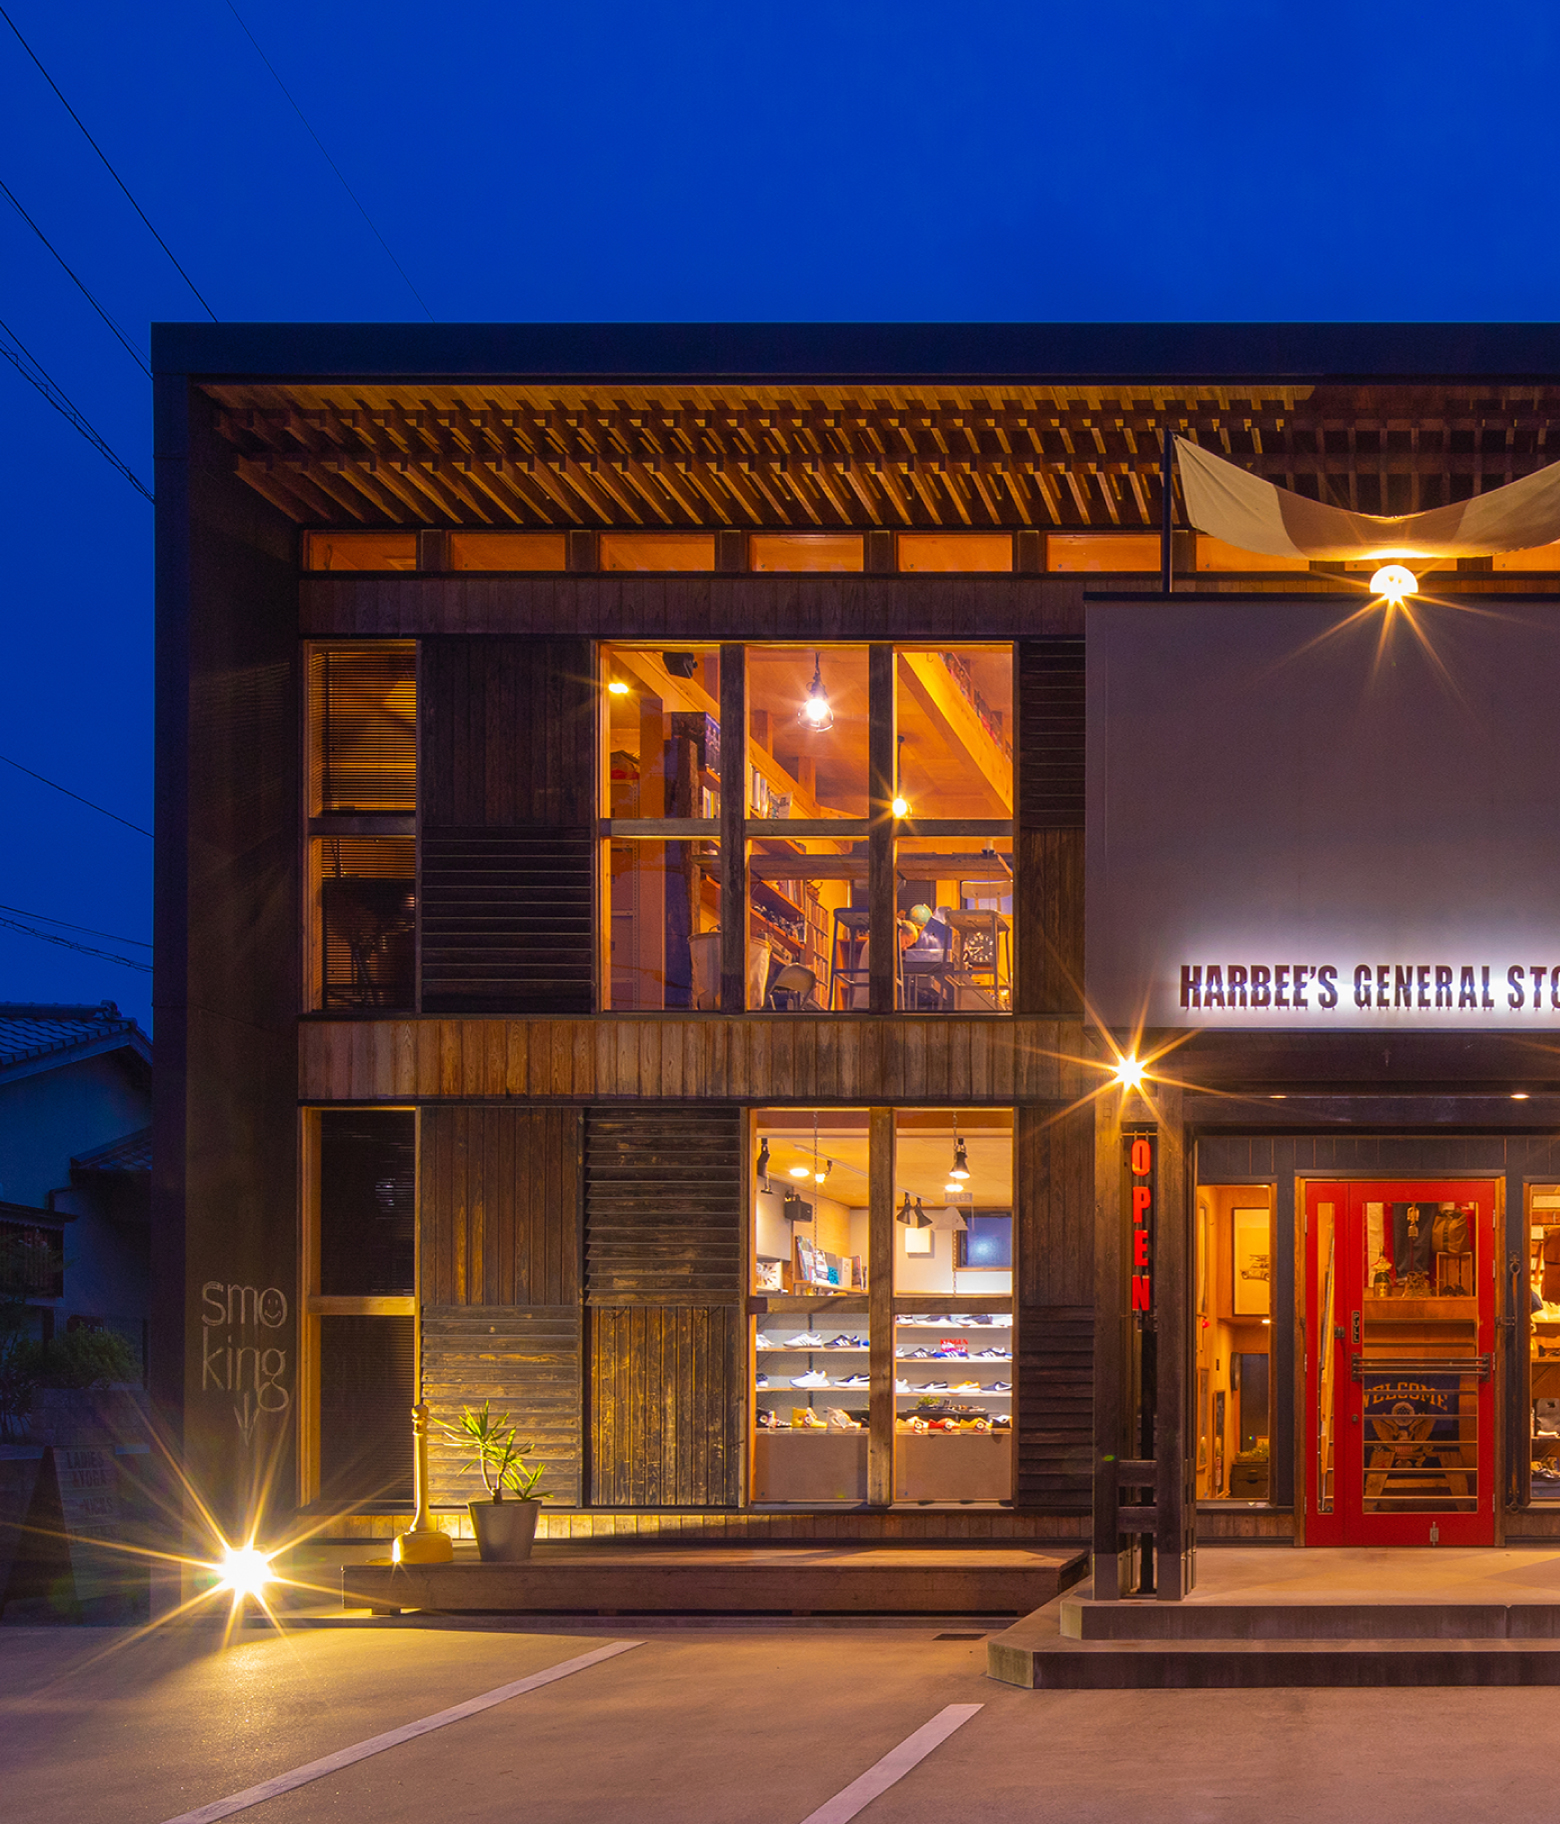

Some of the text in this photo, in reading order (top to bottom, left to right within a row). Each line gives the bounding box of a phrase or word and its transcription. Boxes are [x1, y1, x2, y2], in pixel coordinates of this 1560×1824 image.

[1180, 964, 1338, 1010] HARBEE'S
[1353, 964, 1495, 1009] GENERAL
[1131, 1139, 1151, 1311] OPEN
[202, 1326, 290, 1412] king
